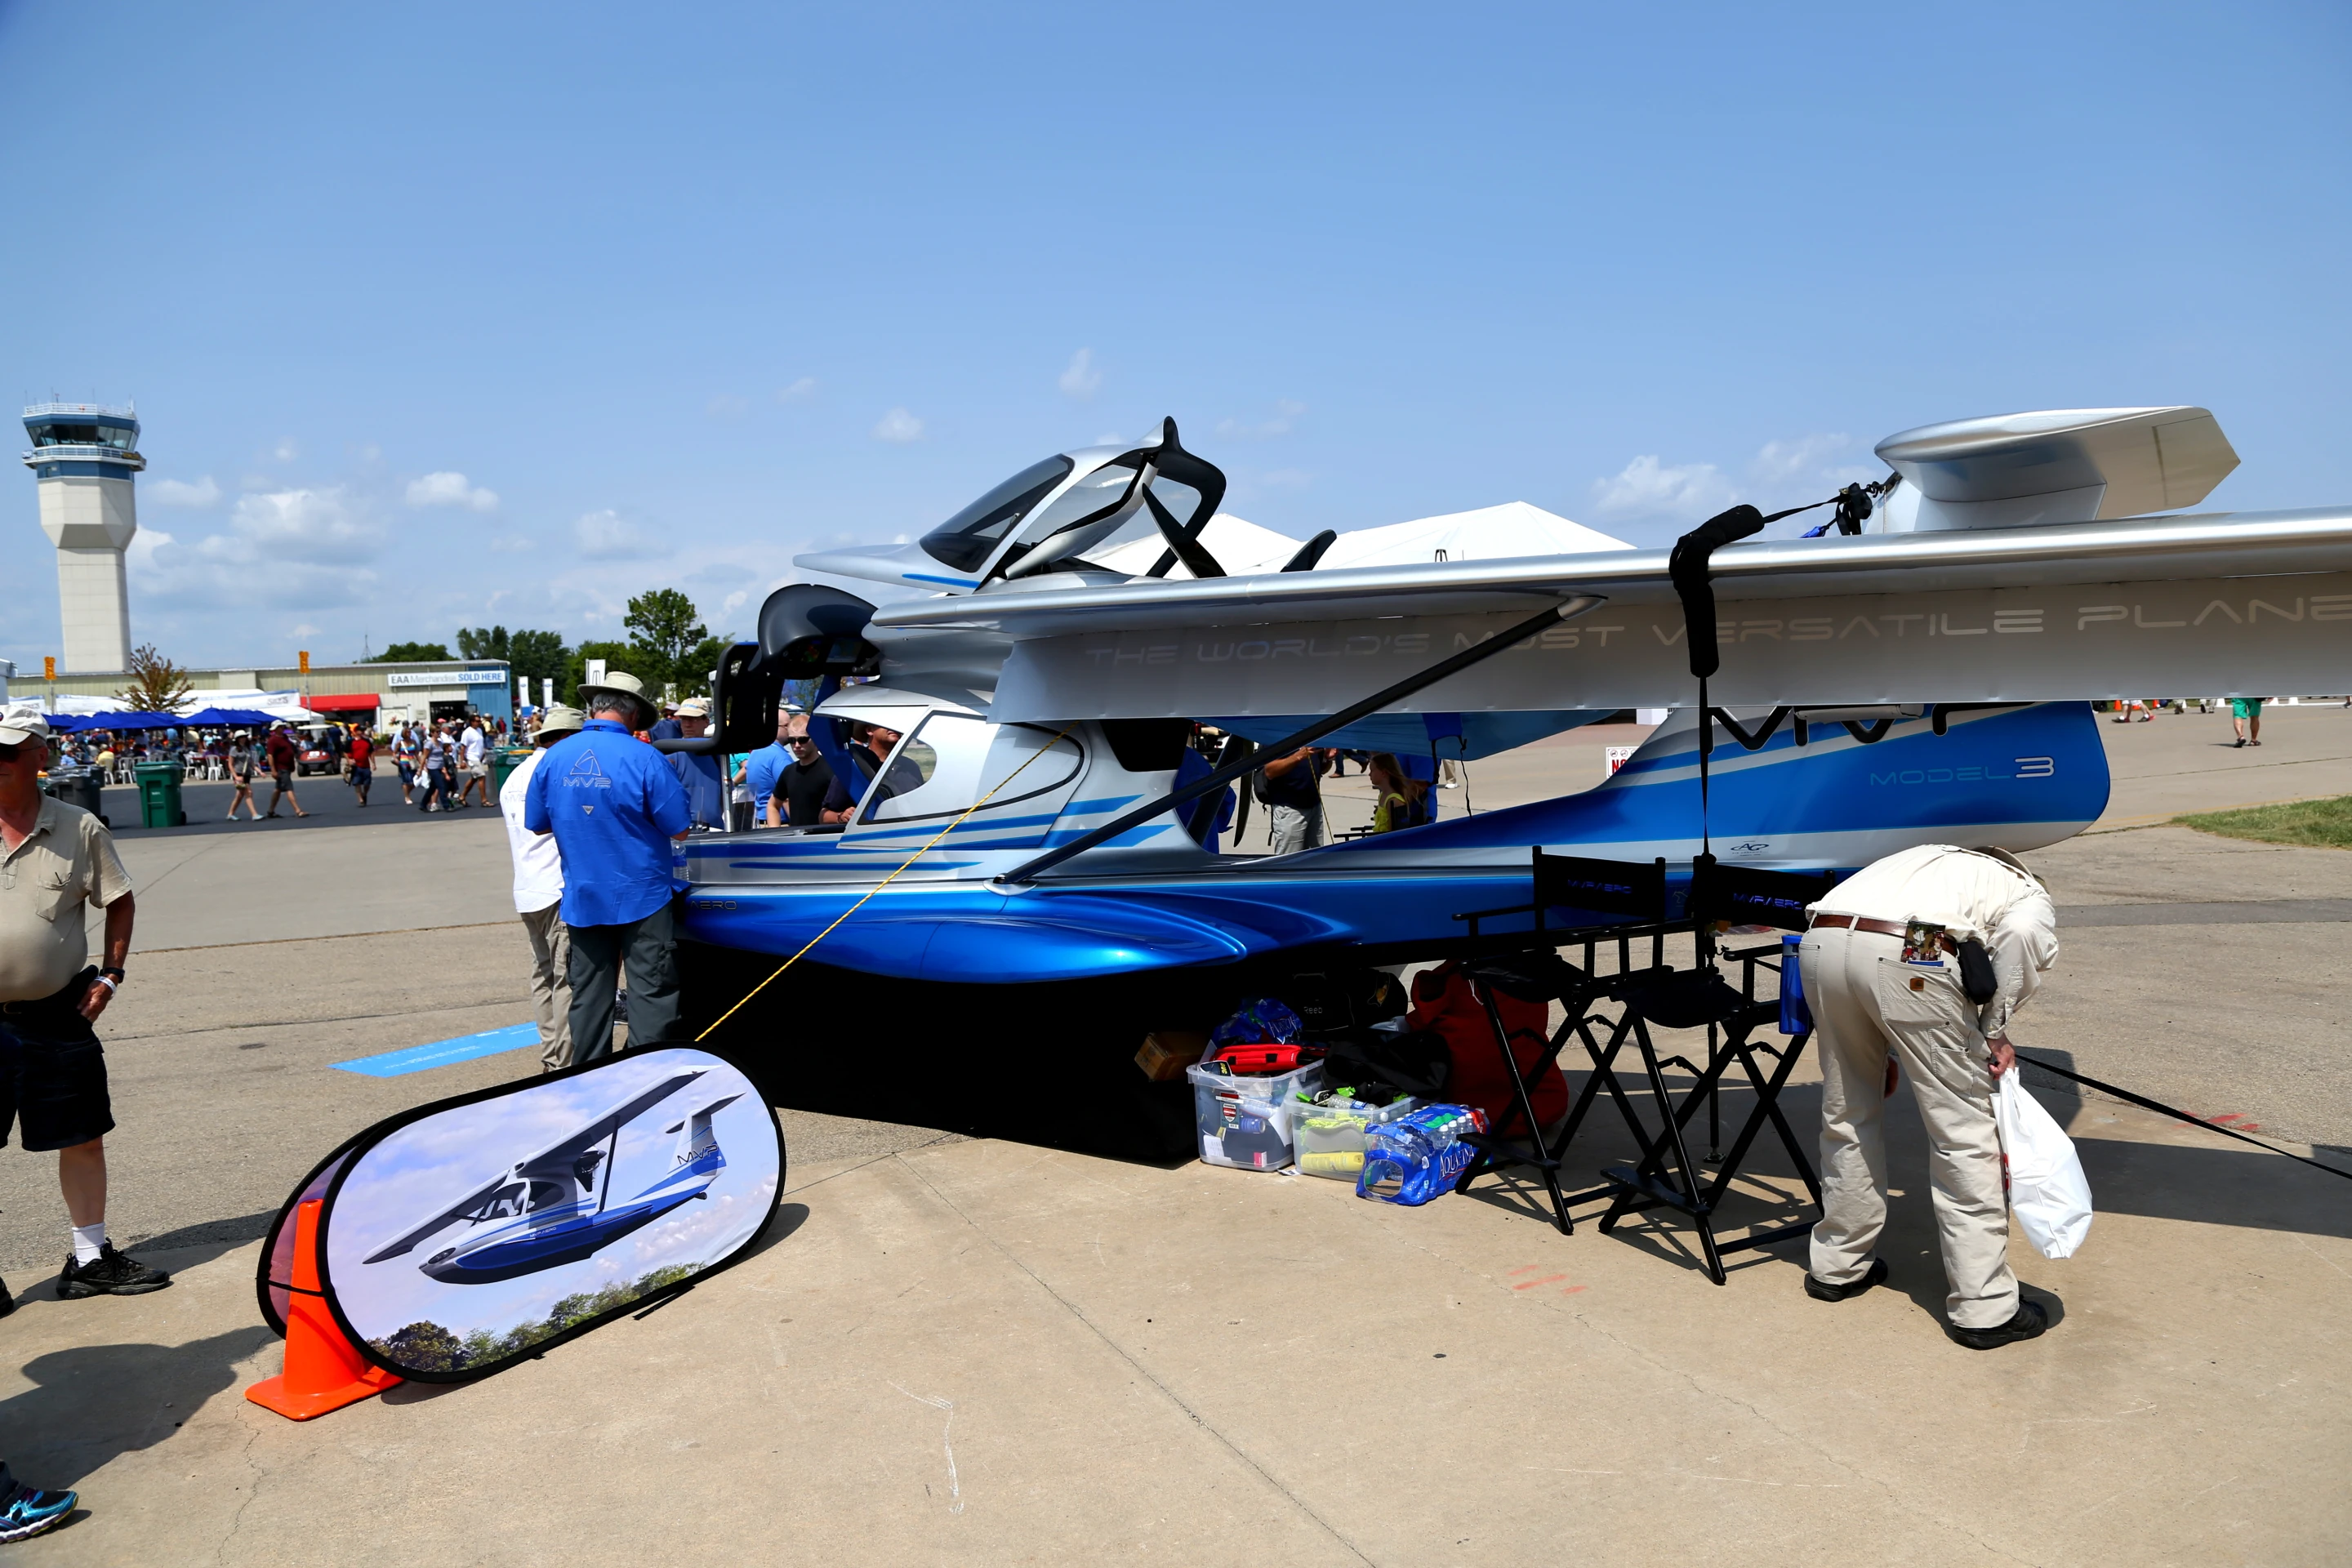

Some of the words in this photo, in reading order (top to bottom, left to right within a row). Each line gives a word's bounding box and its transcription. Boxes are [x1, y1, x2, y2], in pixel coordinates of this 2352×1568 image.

[1085, 644, 1178, 666] THE
[1196, 633, 1430, 663] WORLD'S
[2077, 594, 2352, 631] PLANE
[390, 675, 410, 684] EAA
[410, 674, 457, 684] Merchandise
[458, 673, 479, 682] SOLD
[481, 672, 502, 681] HERE
[563, 777, 612, 788] MVP
[1870, 766, 2011, 786] MODEL
[2014, 755, 2055, 778] 3
[676, 1144, 719, 1165] MVP
[1438, 1145, 1475, 1182] AQUAFINA
